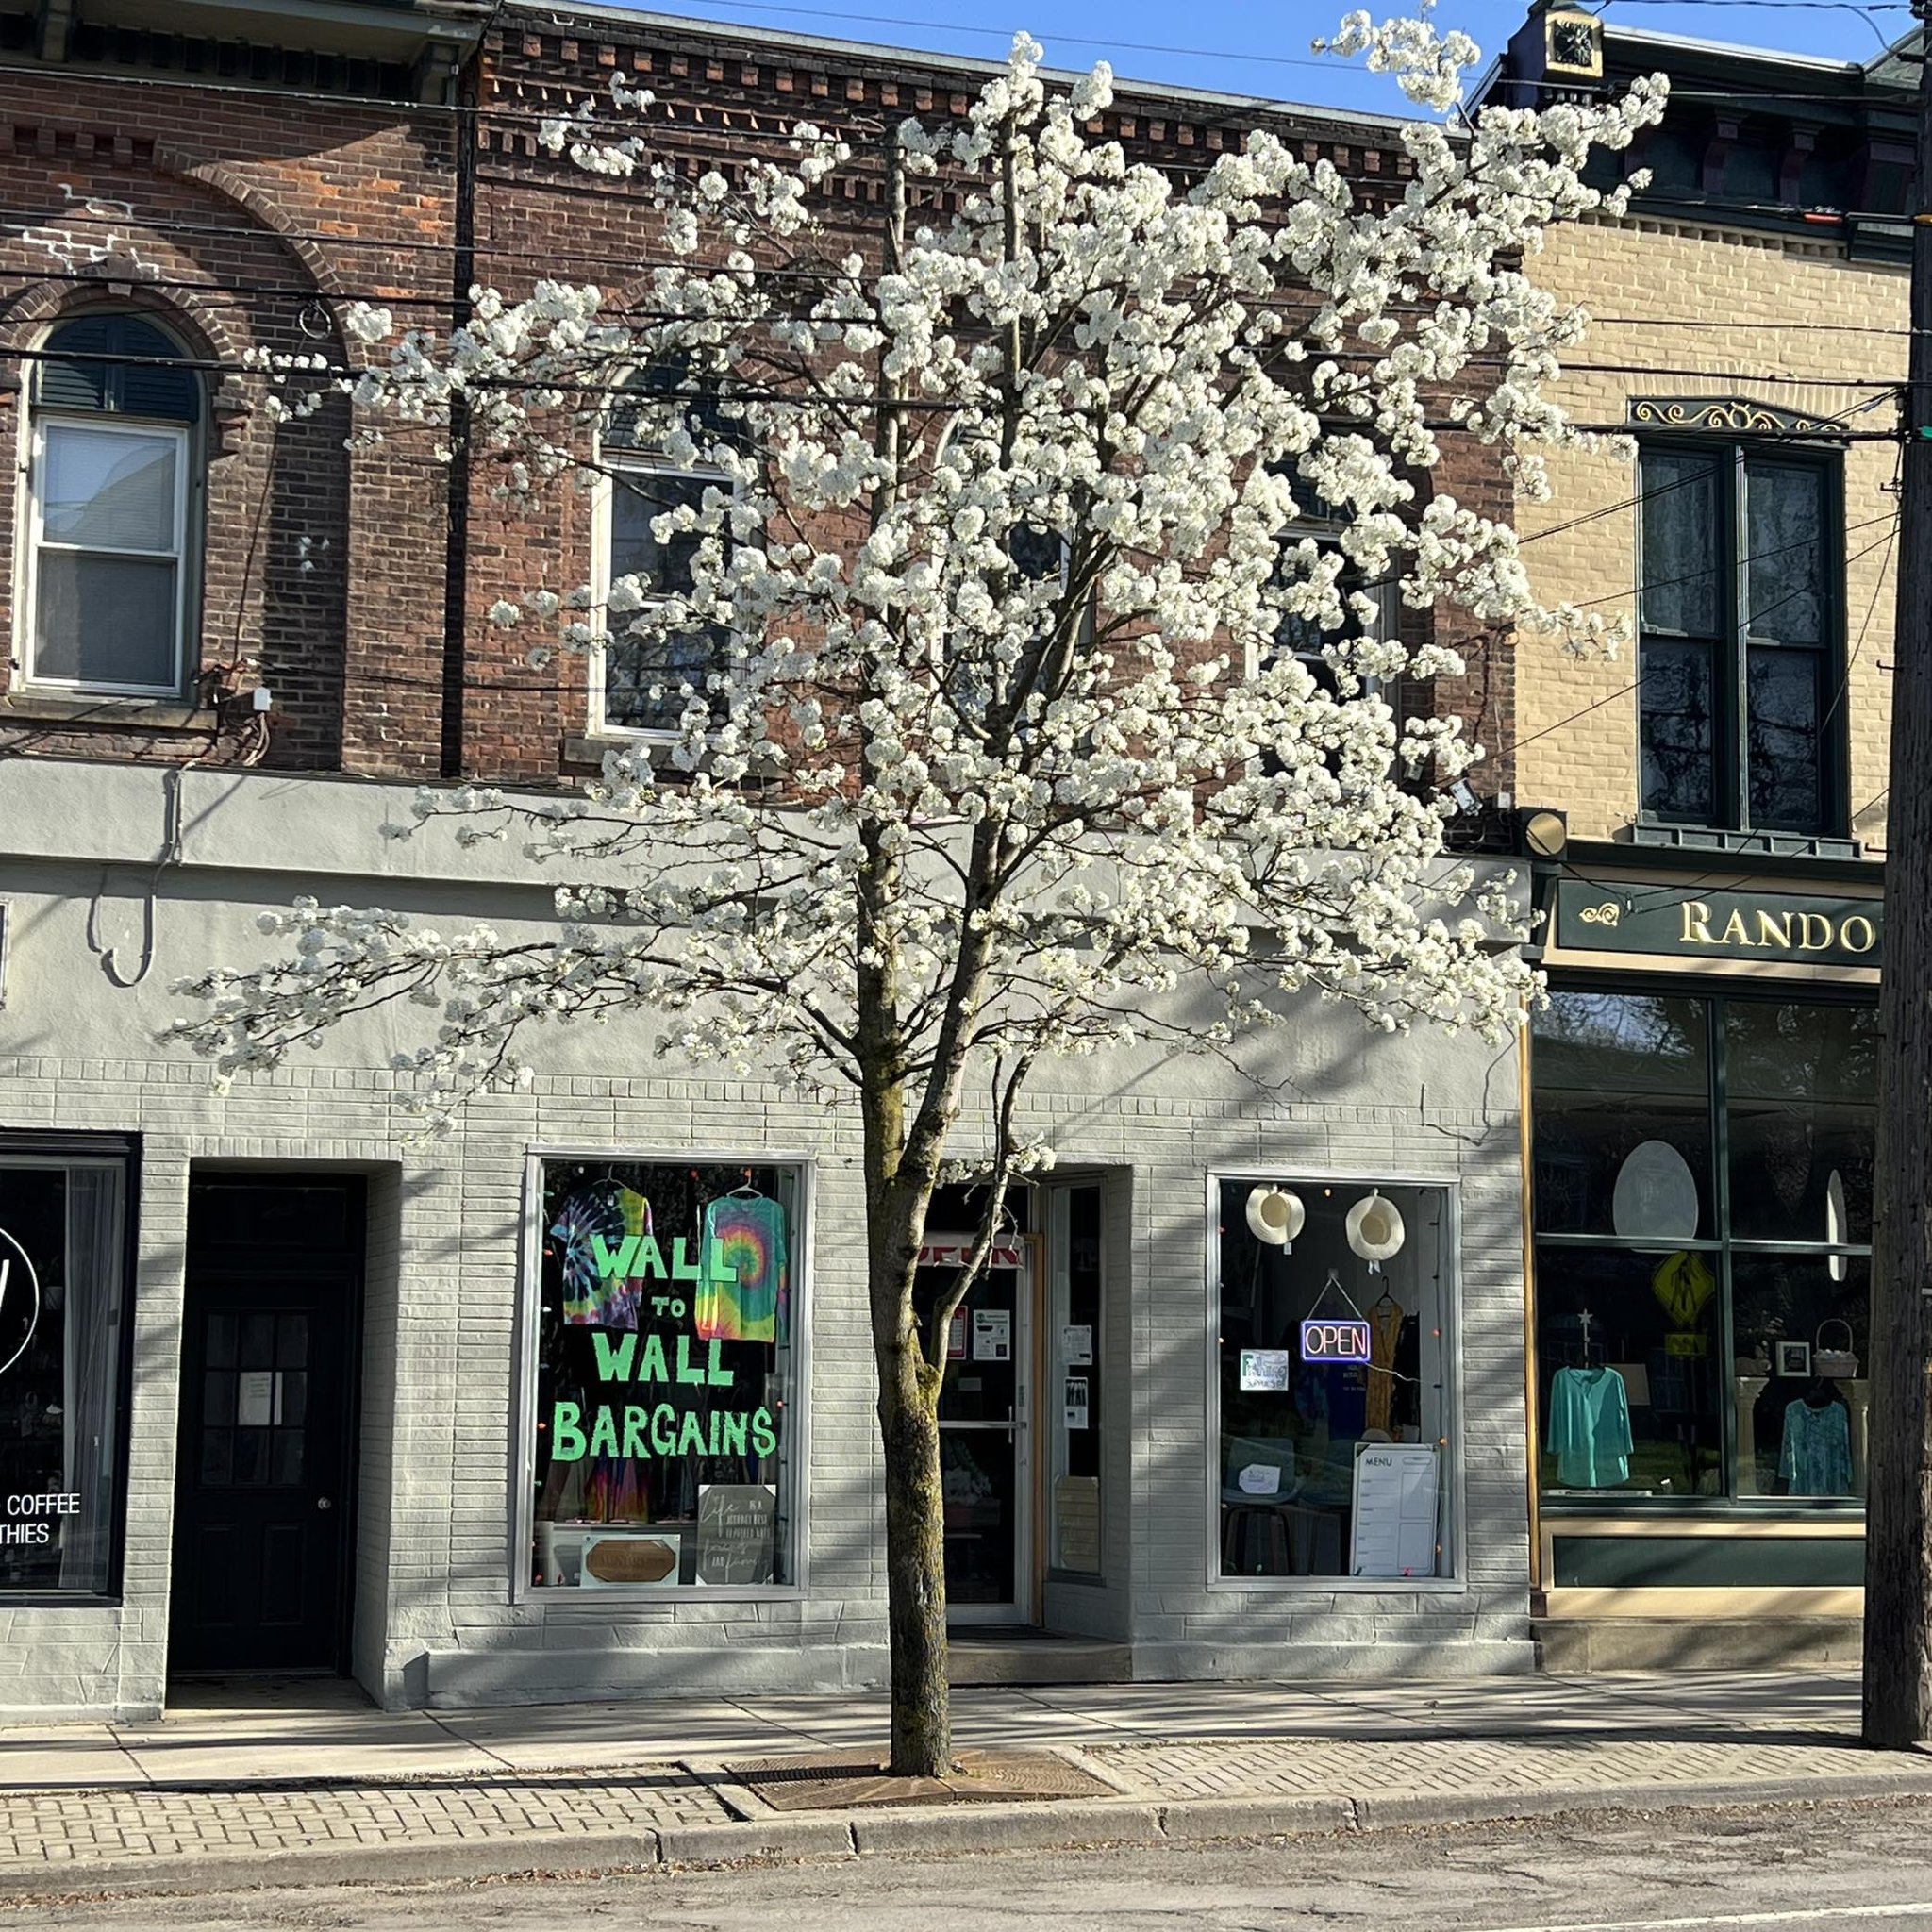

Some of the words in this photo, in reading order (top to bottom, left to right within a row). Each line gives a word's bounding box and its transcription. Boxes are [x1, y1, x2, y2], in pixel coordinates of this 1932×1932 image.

[590, 1234, 738, 1282] WALL
[651, 1296, 687, 1318] TO
[1306, 1325, 1366, 1355] OPEN
[591, 1332, 734, 1386] WALL
[1365, 1457, 1392, 1467] MENU
[7, 1493, 81, 1516] COFFEE
